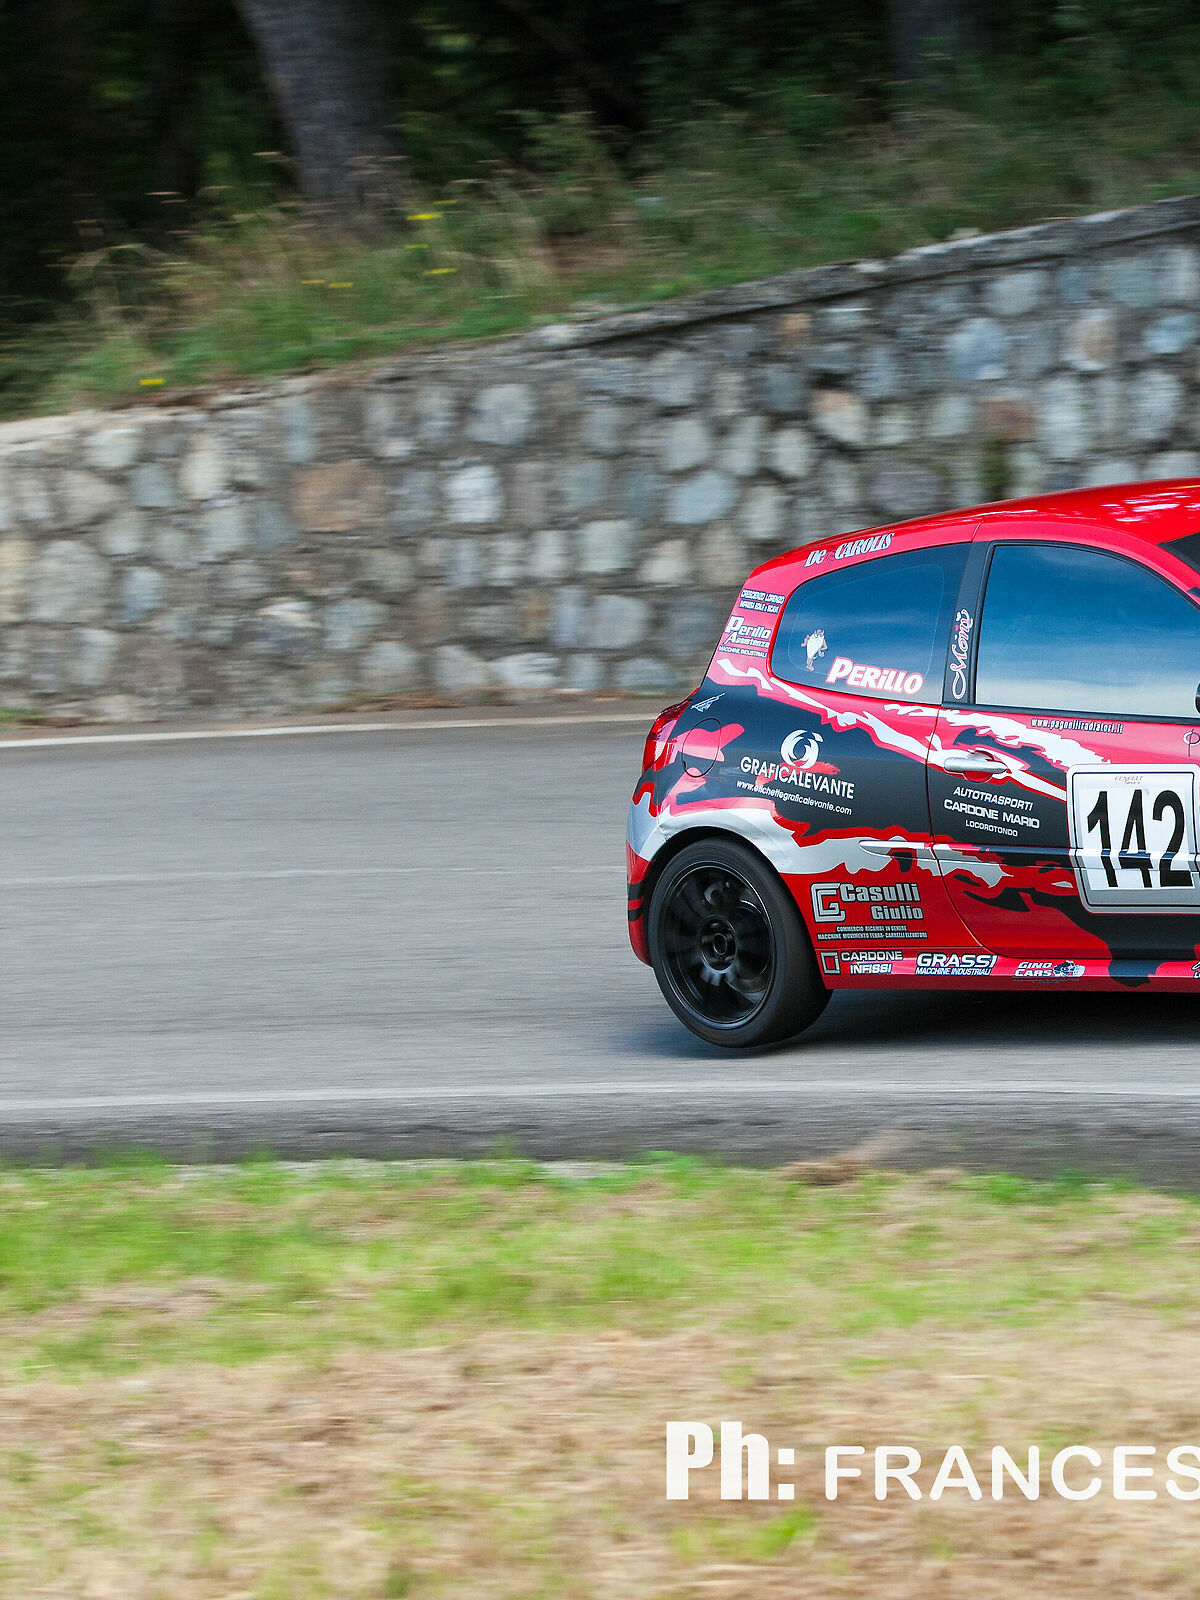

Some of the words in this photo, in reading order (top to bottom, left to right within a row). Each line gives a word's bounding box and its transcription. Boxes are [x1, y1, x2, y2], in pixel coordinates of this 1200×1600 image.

[724, 615, 772, 639] Perillo
[740, 756, 855, 799] GRAFICALEVANTE
[953, 786, 1033, 811] AUTOTRASPORTI
[944, 799, 999, 820] CARDONE
[1003, 811, 1040, 829] MARIO
[965, 819, 1018, 837] LOCOROTONDO
[1086, 789, 1194, 888] 142
[839, 882, 921, 902] Casulli
[870, 904, 924, 920] Giulio
[841, 950, 903, 961] CARDONE
[916, 952, 998, 968] GRASSI
[915, 967, 950, 976] MACCHINE
[950, 967, 992, 976] INDUSTRIALI
[1014, 968, 1053, 977] CARS
[1018, 961, 1053, 969] GINO
